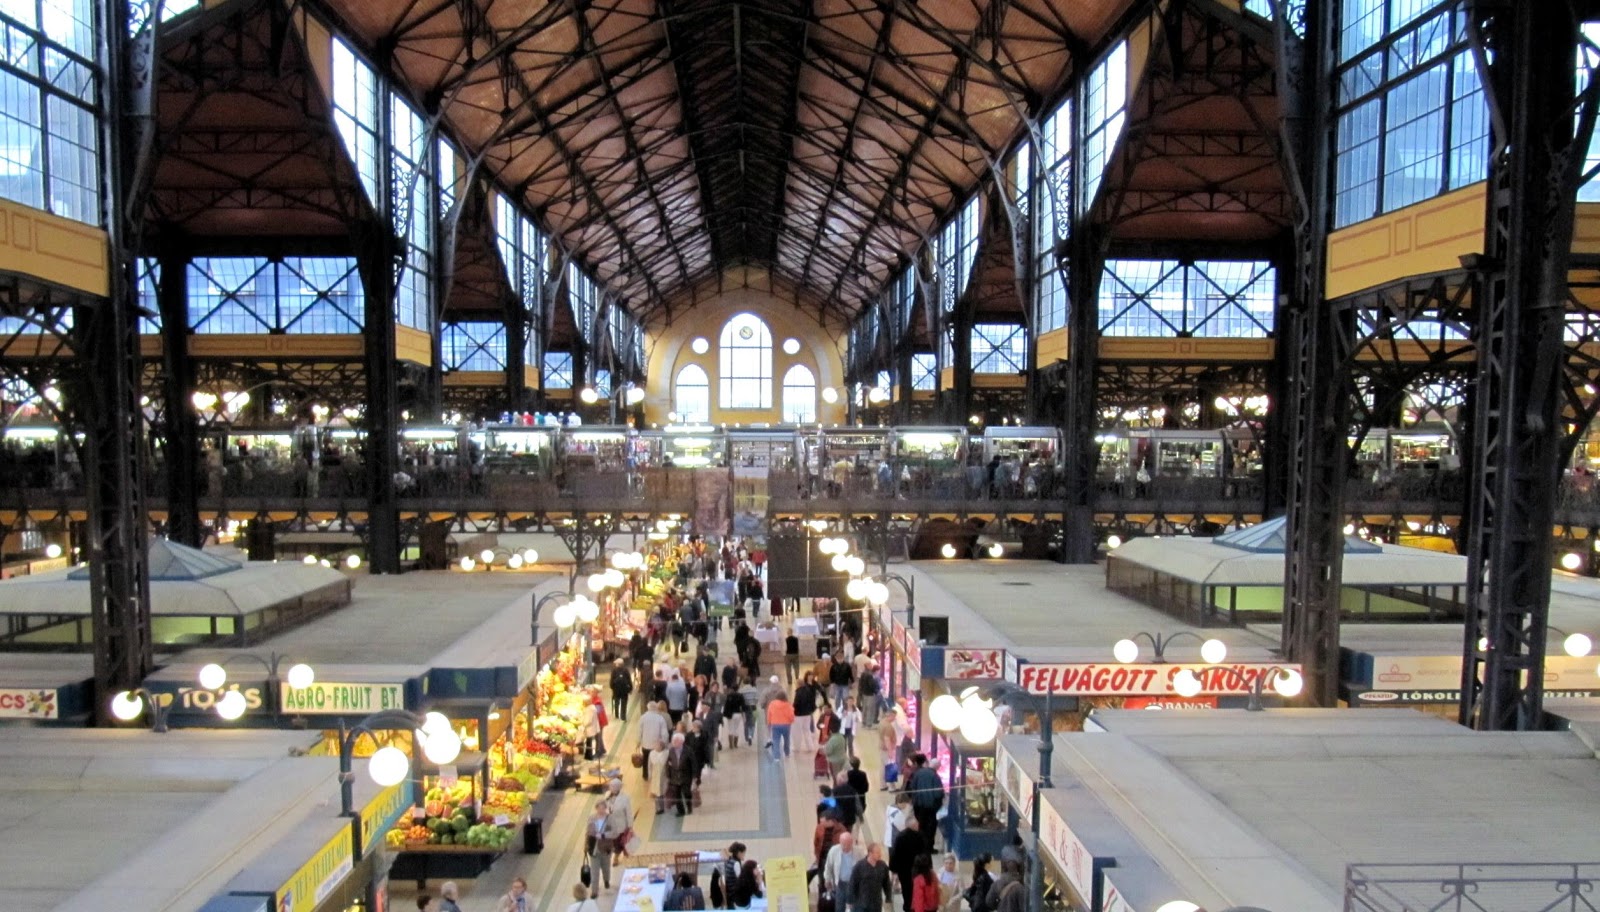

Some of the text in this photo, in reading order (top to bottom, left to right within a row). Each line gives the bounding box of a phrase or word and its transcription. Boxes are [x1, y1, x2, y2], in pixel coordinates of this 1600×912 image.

[1023, 664, 1158, 691] FELVÁGOTT
[0, 693, 25, 709] CS
[286, 686, 400, 709] AGRO-FRUIT BT.
